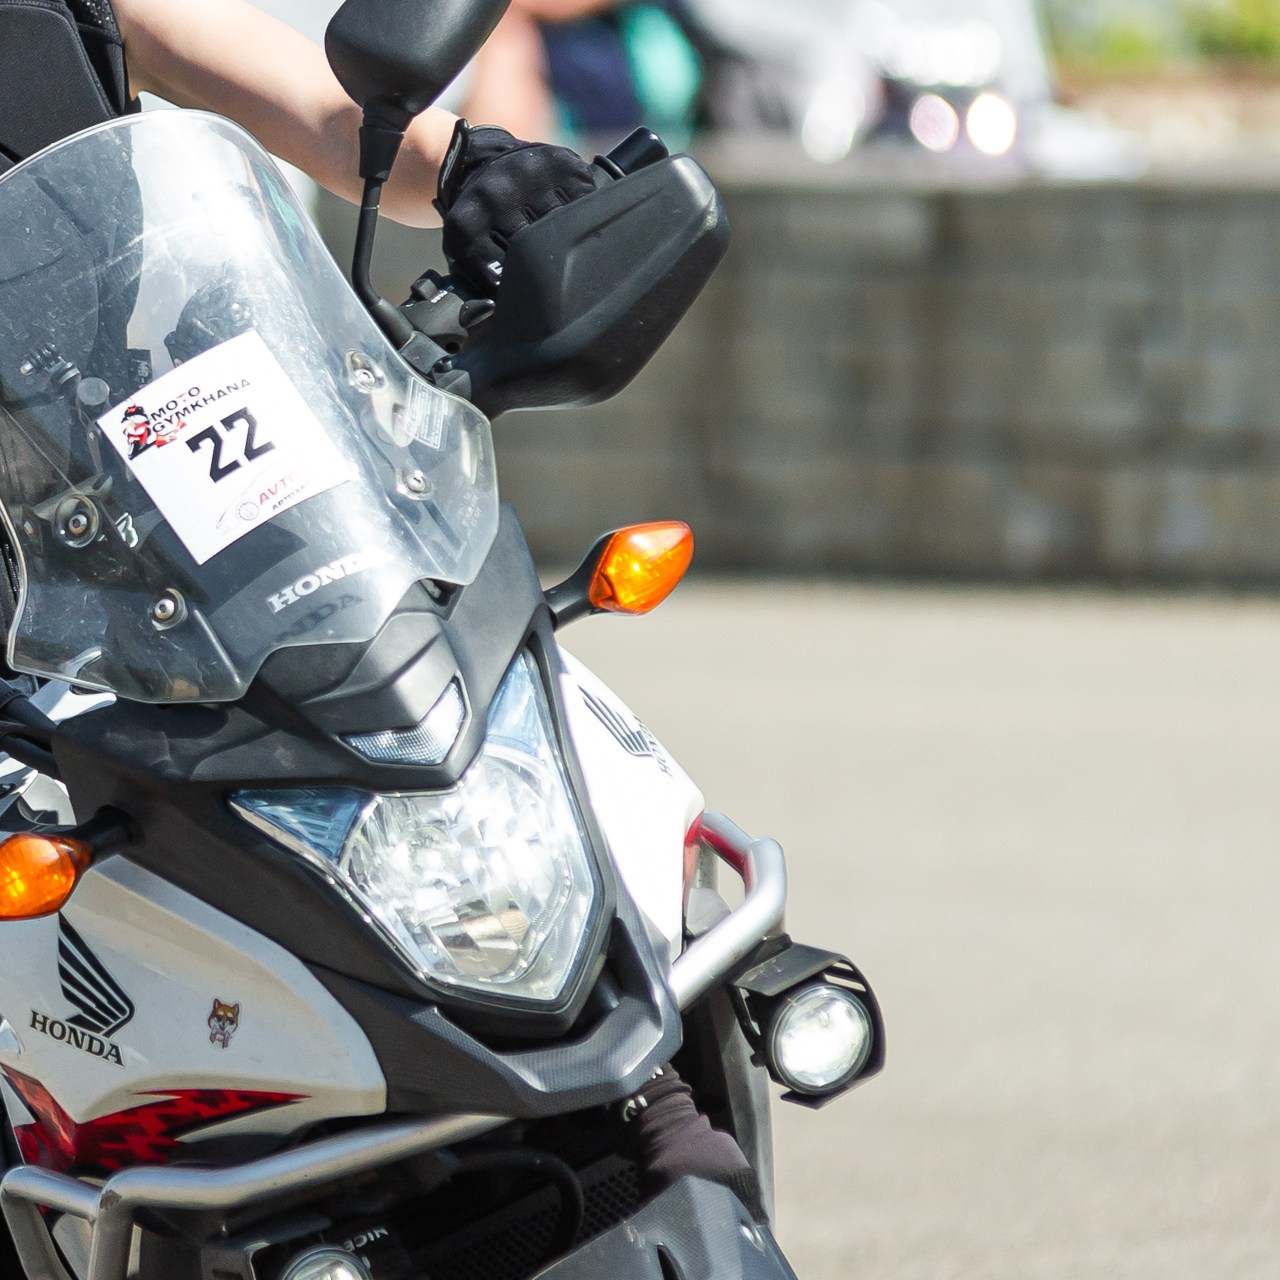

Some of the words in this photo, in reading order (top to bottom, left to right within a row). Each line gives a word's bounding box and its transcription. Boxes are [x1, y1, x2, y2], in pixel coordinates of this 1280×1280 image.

[150, 386, 201, 422] MOTO
[152, 378, 251, 433] GYMKHANA
[185, 406, 276, 483] 22
[267, 547, 395, 614] HOND
[29, 1009, 125, 1067] HONDA
